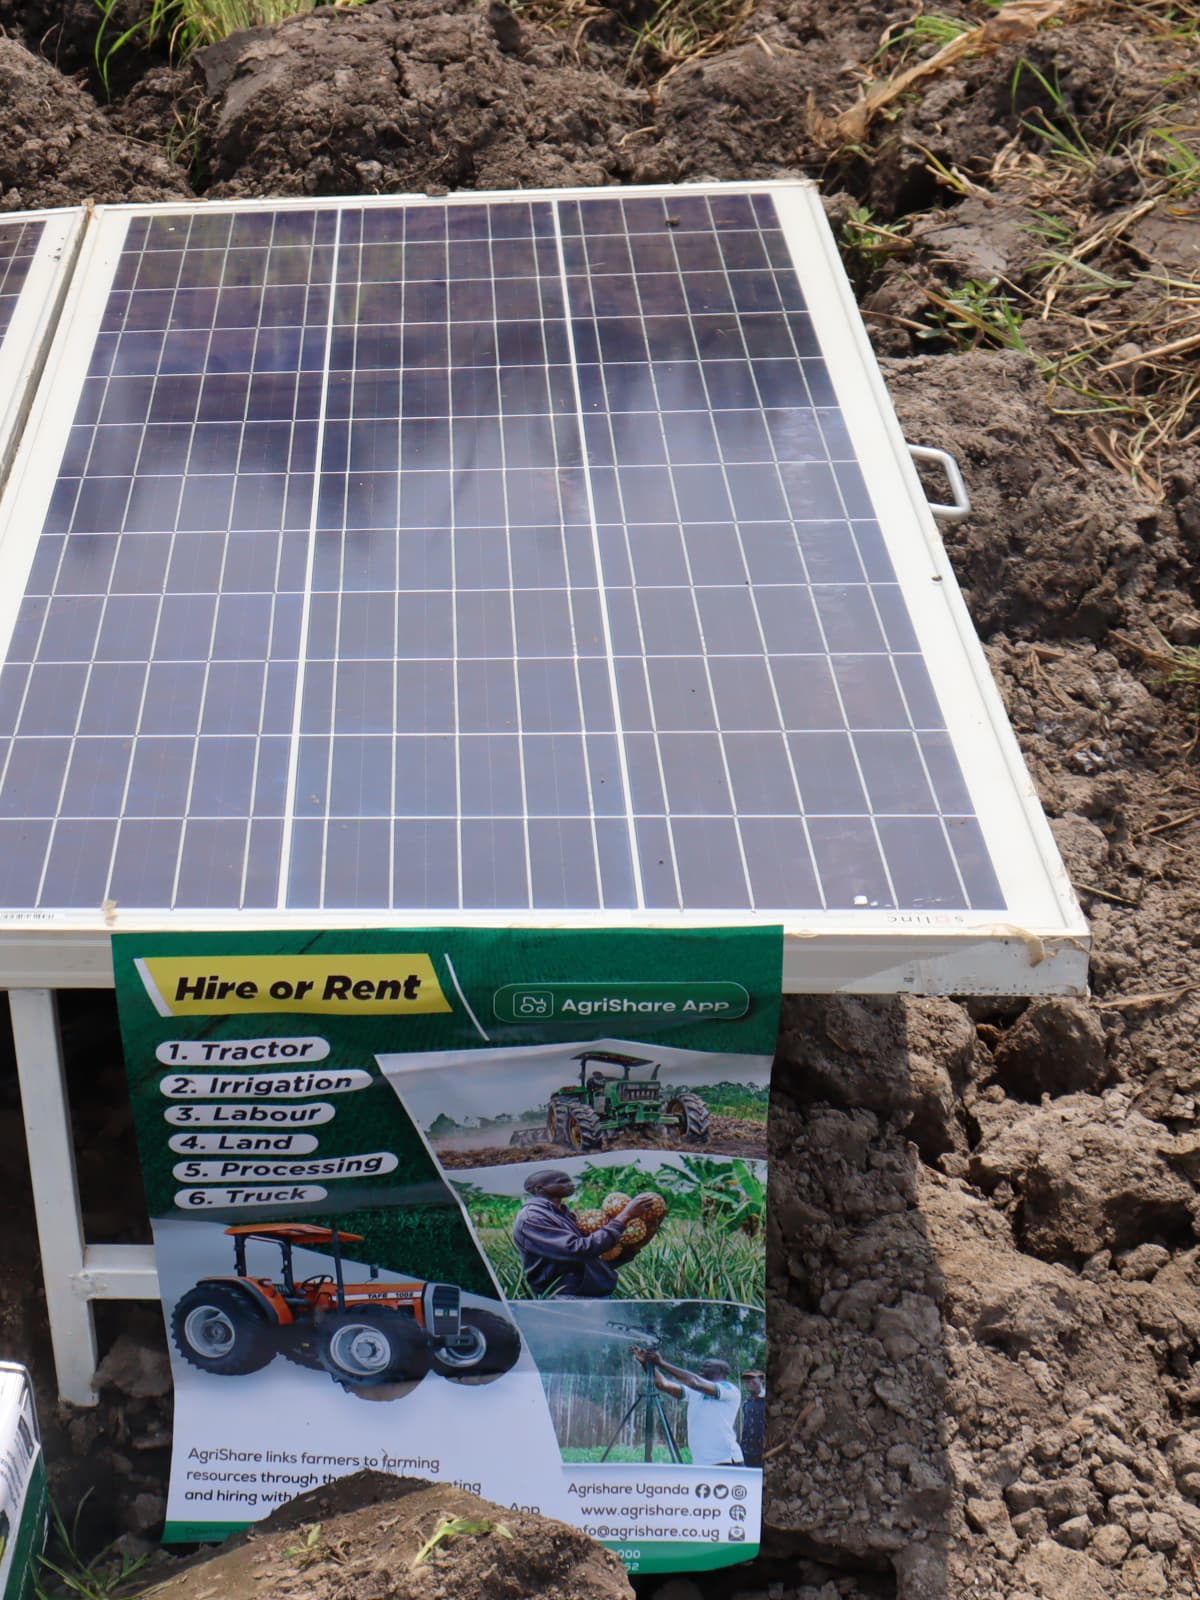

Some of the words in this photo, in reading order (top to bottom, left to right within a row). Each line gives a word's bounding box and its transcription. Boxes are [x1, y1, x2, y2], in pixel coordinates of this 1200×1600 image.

[175, 975, 258, 1001] Hire
[269, 980, 314, 1001] or
[322, 974, 422, 1001] Rent
[561, 997, 677, 1016] AgriShare
[682, 999, 731, 1013] App
[168, 1043, 188, 1060] 1.
[201, 1041, 314, 1061] Tractor
[171, 1077, 197, 1094] 2.
[209, 1073, 353, 1096] Irrigation
[176, 1106, 200, 1122] 3.
[213, 1106, 322, 1122] Labour
[180, 1135, 206, 1150] 4.
[218, 1135, 293, 1150] Land
[184, 1162, 209, 1177] 5.
[220, 1156, 383, 1177] Processing
[188, 1190, 212, 1206] 6.
[226, 1187, 308, 1204] Truck
[188, 1448, 263, 1464] AgriShare
[266, 1450, 297, 1464] links
[301, 1452, 360, 1466] farmers
[364, 1455, 378, 1467] to
[382, 1455, 440, 1473] farming
[186, 1471, 257, 1483] resources
[260, 1472, 318, 1488] through
[185, 1490, 213, 1501] and
[217, 1490, 258, 1505] hiring
[258, 1491, 292, 1502] with
[568, 1483, 632, 1497] Agrishare
[636, 1483, 689, 1498] Uganda
[581, 1504, 721, 1520] www.agrishare.app
[575, 1525, 720, 1542] nfo@agrishare.co.ug
